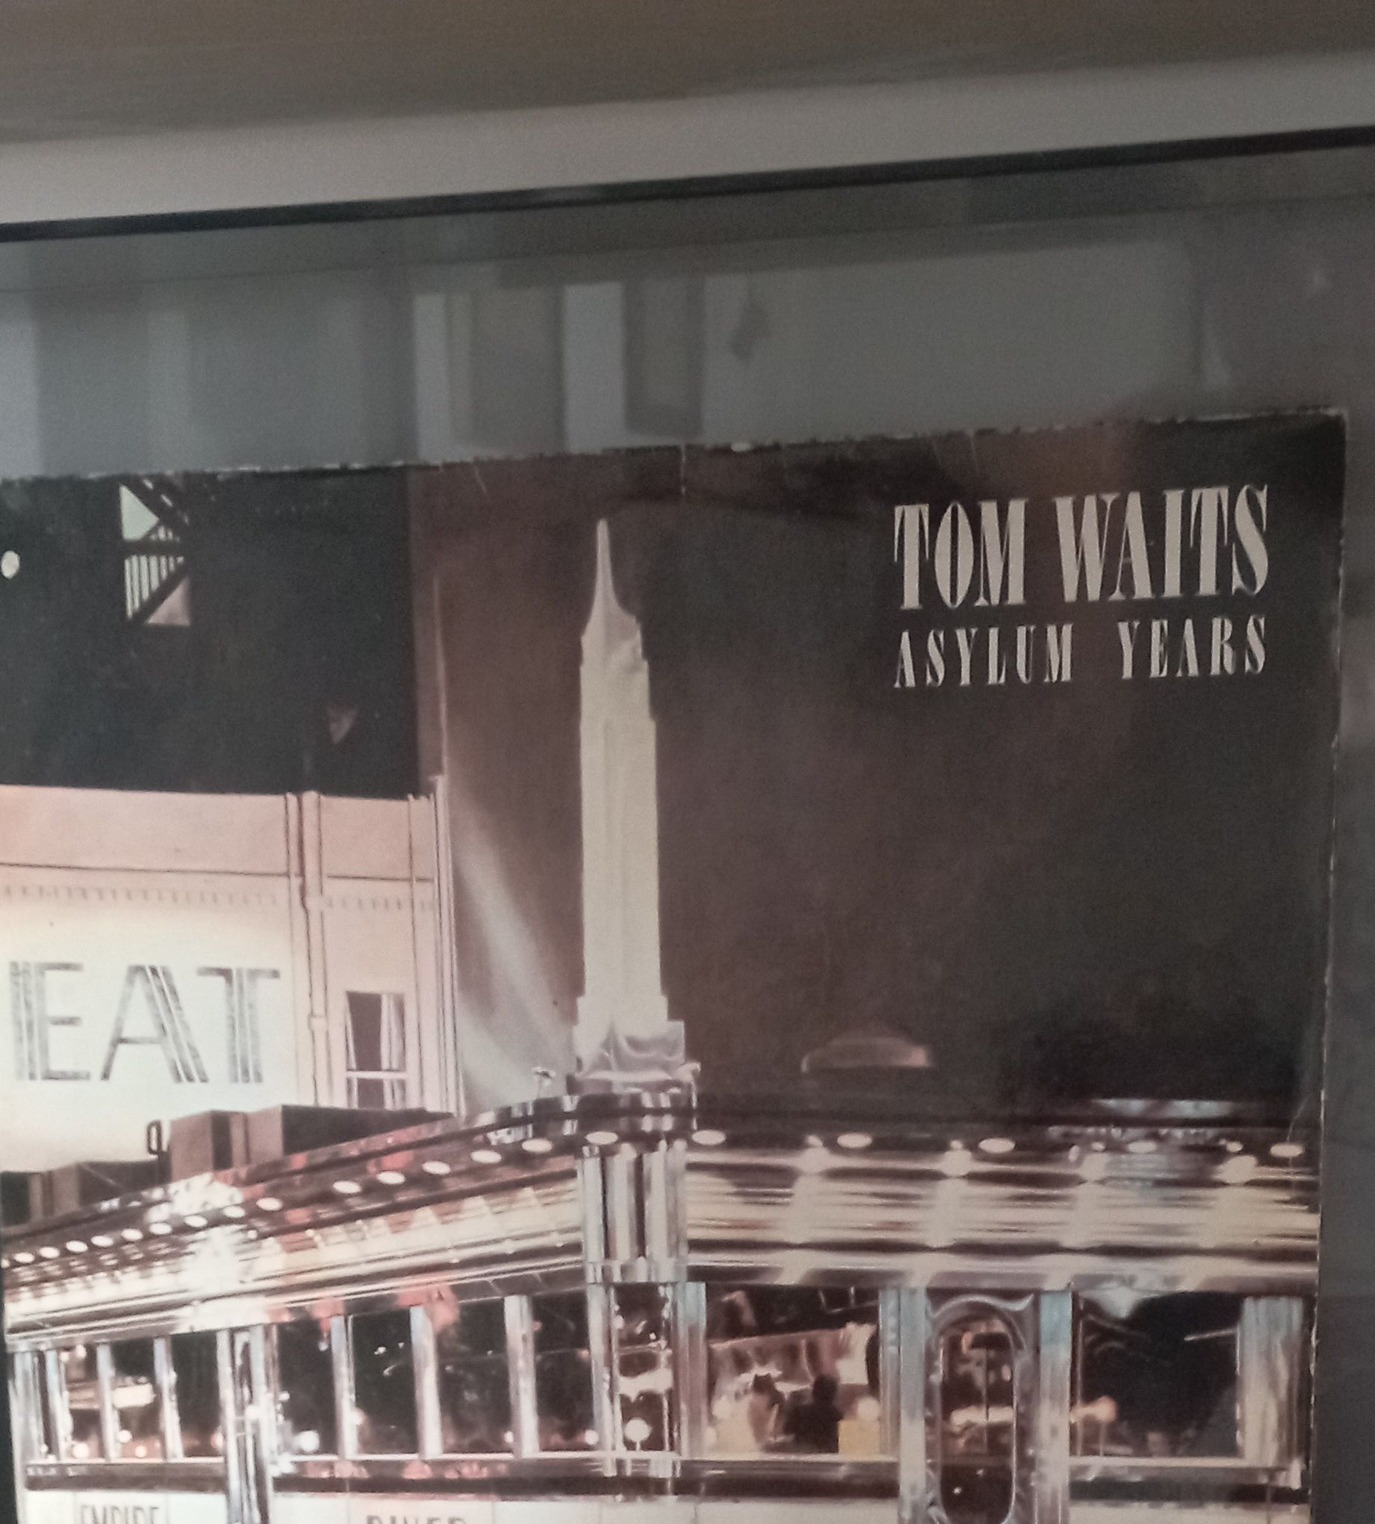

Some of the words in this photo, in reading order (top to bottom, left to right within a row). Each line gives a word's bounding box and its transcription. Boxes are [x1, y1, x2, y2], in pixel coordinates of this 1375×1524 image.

[893, 498, 1030, 610] TOM
[1053, 484, 1269, 603] WAITS
[893, 623, 1073, 688] ASYLUM
[1117, 614, 1266, 679] YEARS
[9, 961, 280, 1083] EAT
